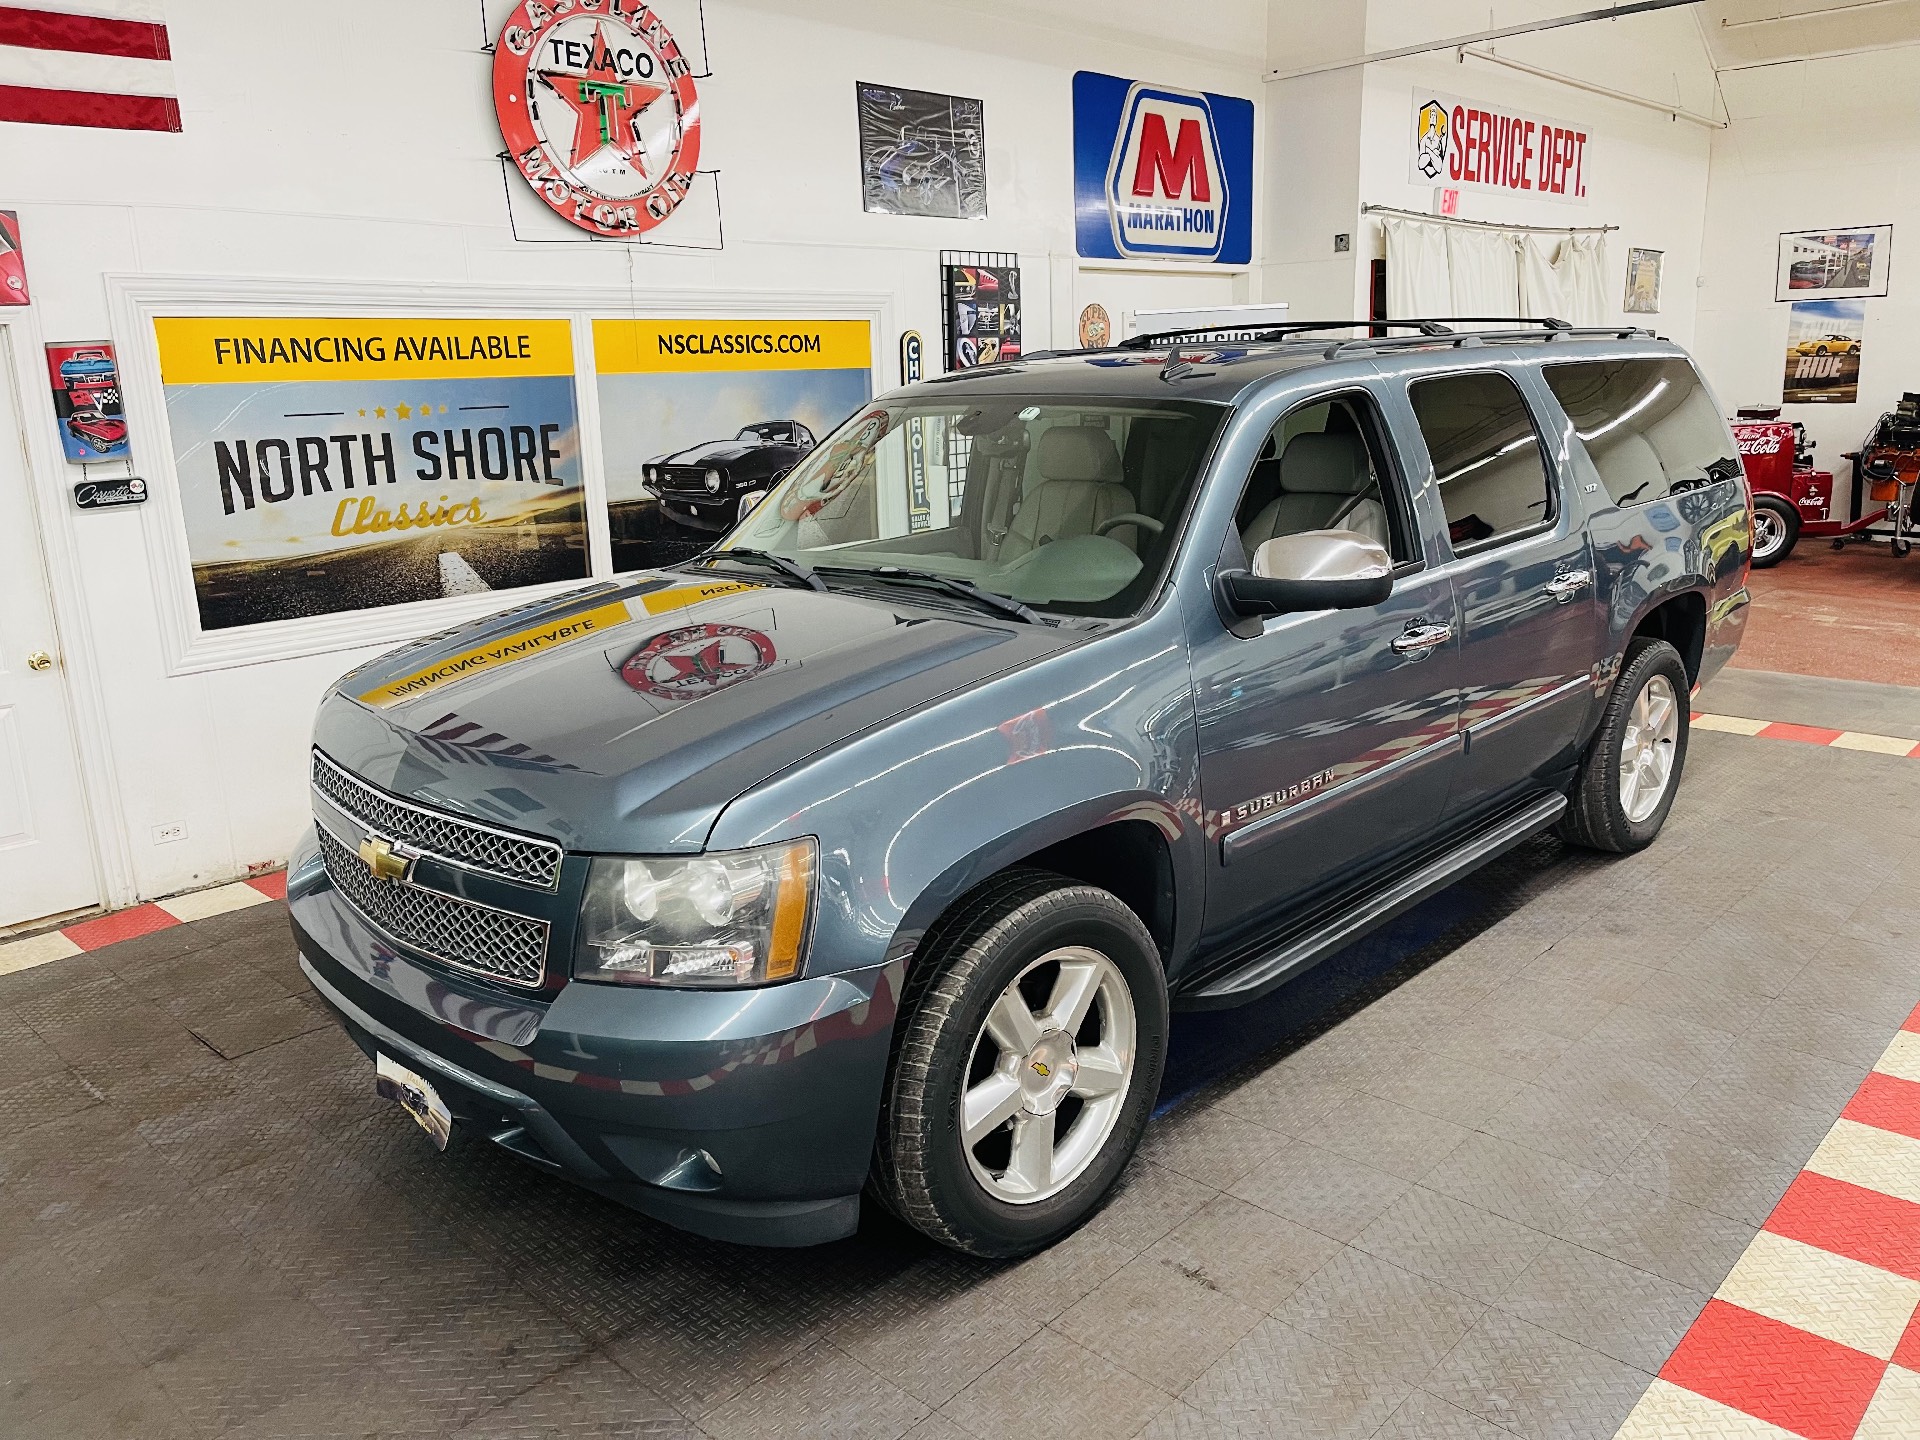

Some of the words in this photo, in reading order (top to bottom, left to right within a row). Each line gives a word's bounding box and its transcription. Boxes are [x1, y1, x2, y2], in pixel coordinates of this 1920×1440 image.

[548, 38, 654, 79] TEXACO
[1132, 112, 1211, 203] M
[1450, 105, 1535, 190] SERVICE
[1538, 125, 1587, 198] DEPT.
[1127, 202, 1215, 234] MARATHON
[1441, 189, 1459, 215] EXIT
[213, 336, 387, 365] FINANCING
[393, 335, 532, 361] AVAILABLE
[657, 334, 821, 355] NSCLASSICS.COM
[1794, 356, 1843, 378] RIDE
[213, 431, 398, 516] NORTH
[411, 422, 565, 488] SHORE
[77, 484, 130, 505] Corvette
[330, 493, 487, 538] Classics
[1236, 769, 1335, 821] SUBURBAN
